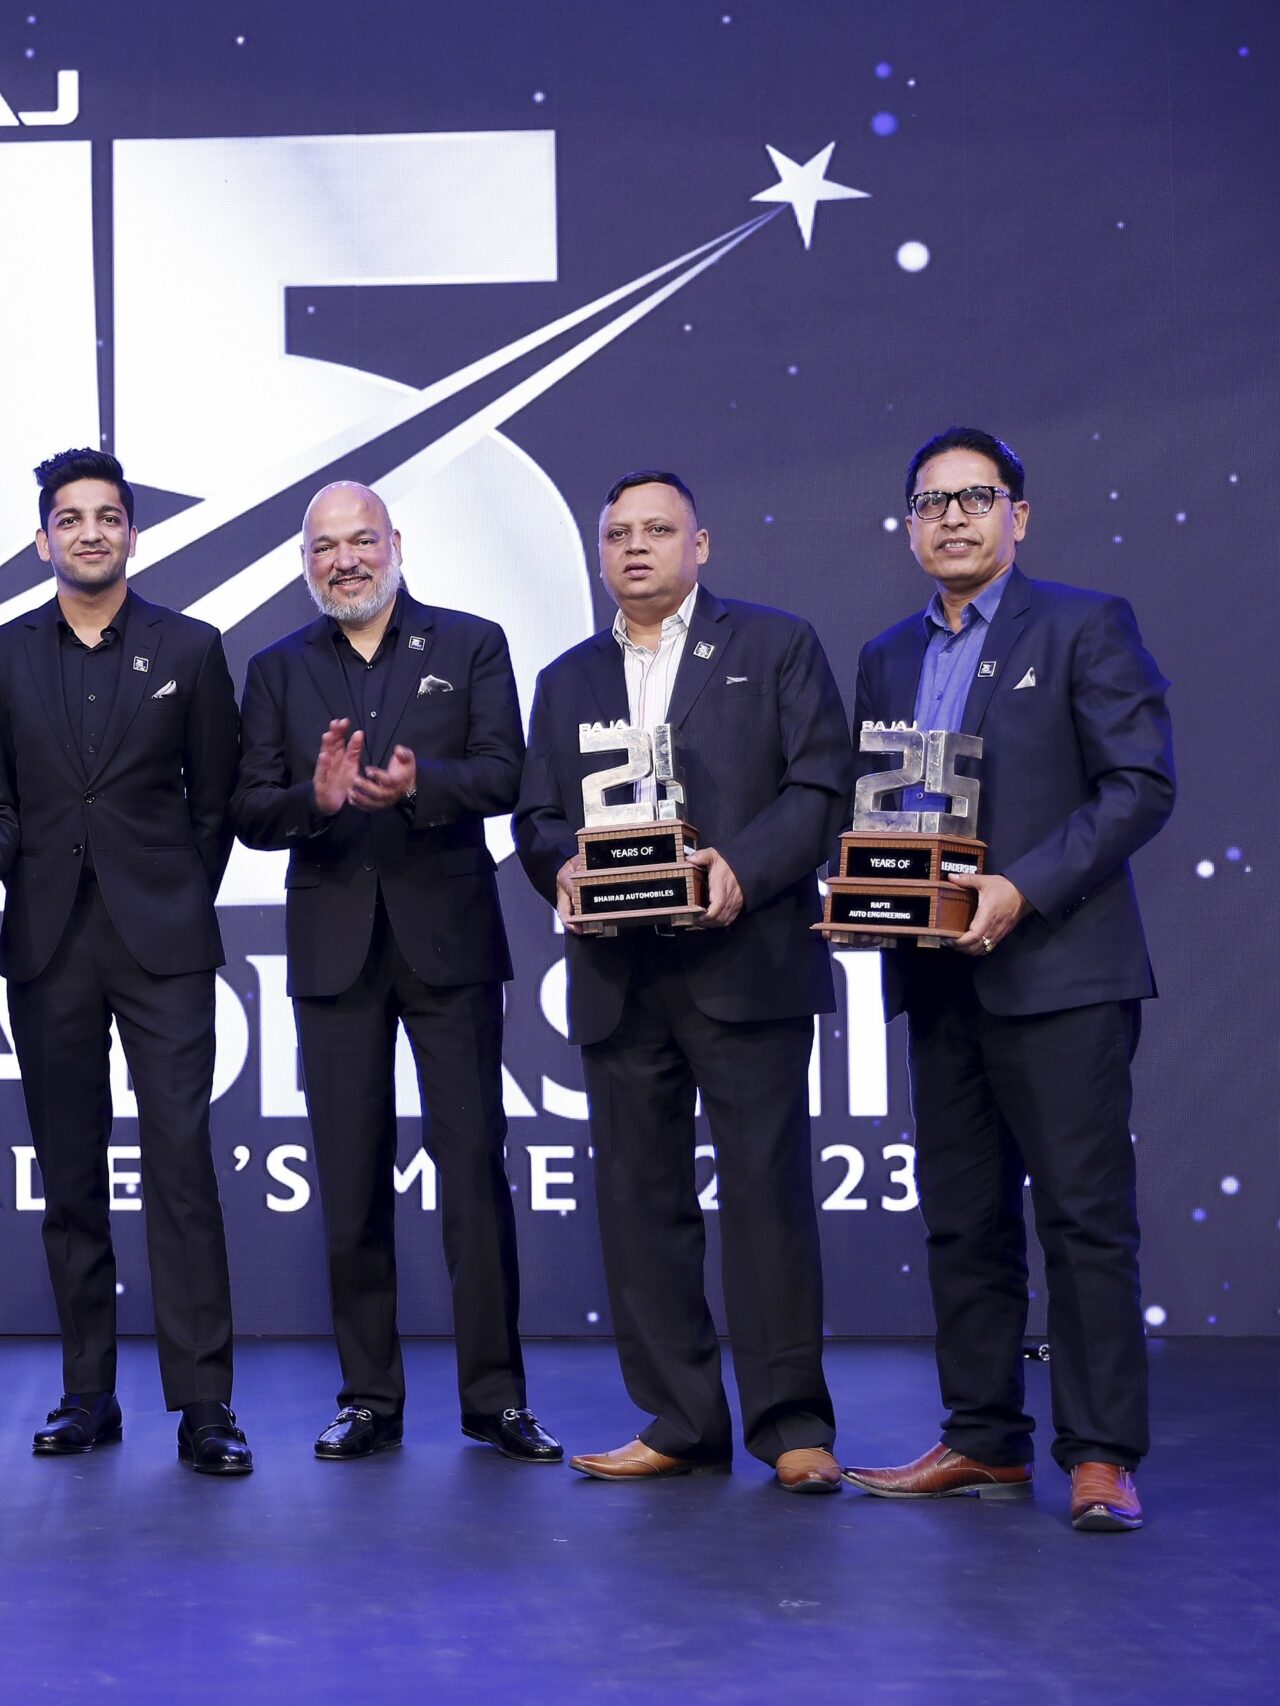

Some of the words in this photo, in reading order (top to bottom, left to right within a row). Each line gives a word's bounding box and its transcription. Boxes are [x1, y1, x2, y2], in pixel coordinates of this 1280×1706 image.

[578, 719, 632, 733] BAJA
[861, 720, 918, 732] BAJAJ
[852, 730, 984, 839] 25
[610, 847, 639, 859] YEARS
[640, 846, 654, 856] OF
[870, 858, 896, 868] YEARS
[897, 859, 911, 869] OF
[941, 861, 978, 875] LEADERSHIP
[593, 893, 625, 903] BHAIRAB
[625, 889, 674, 900] AUTOMOBILES
[870, 901, 891, 909] RAPTI
[849, 909, 867, 918] AUTO
[867, 910, 911, 920] ENGINEERING
[392, 1145, 594, 1213] ME
[693, 1144, 920, 1213] 223
